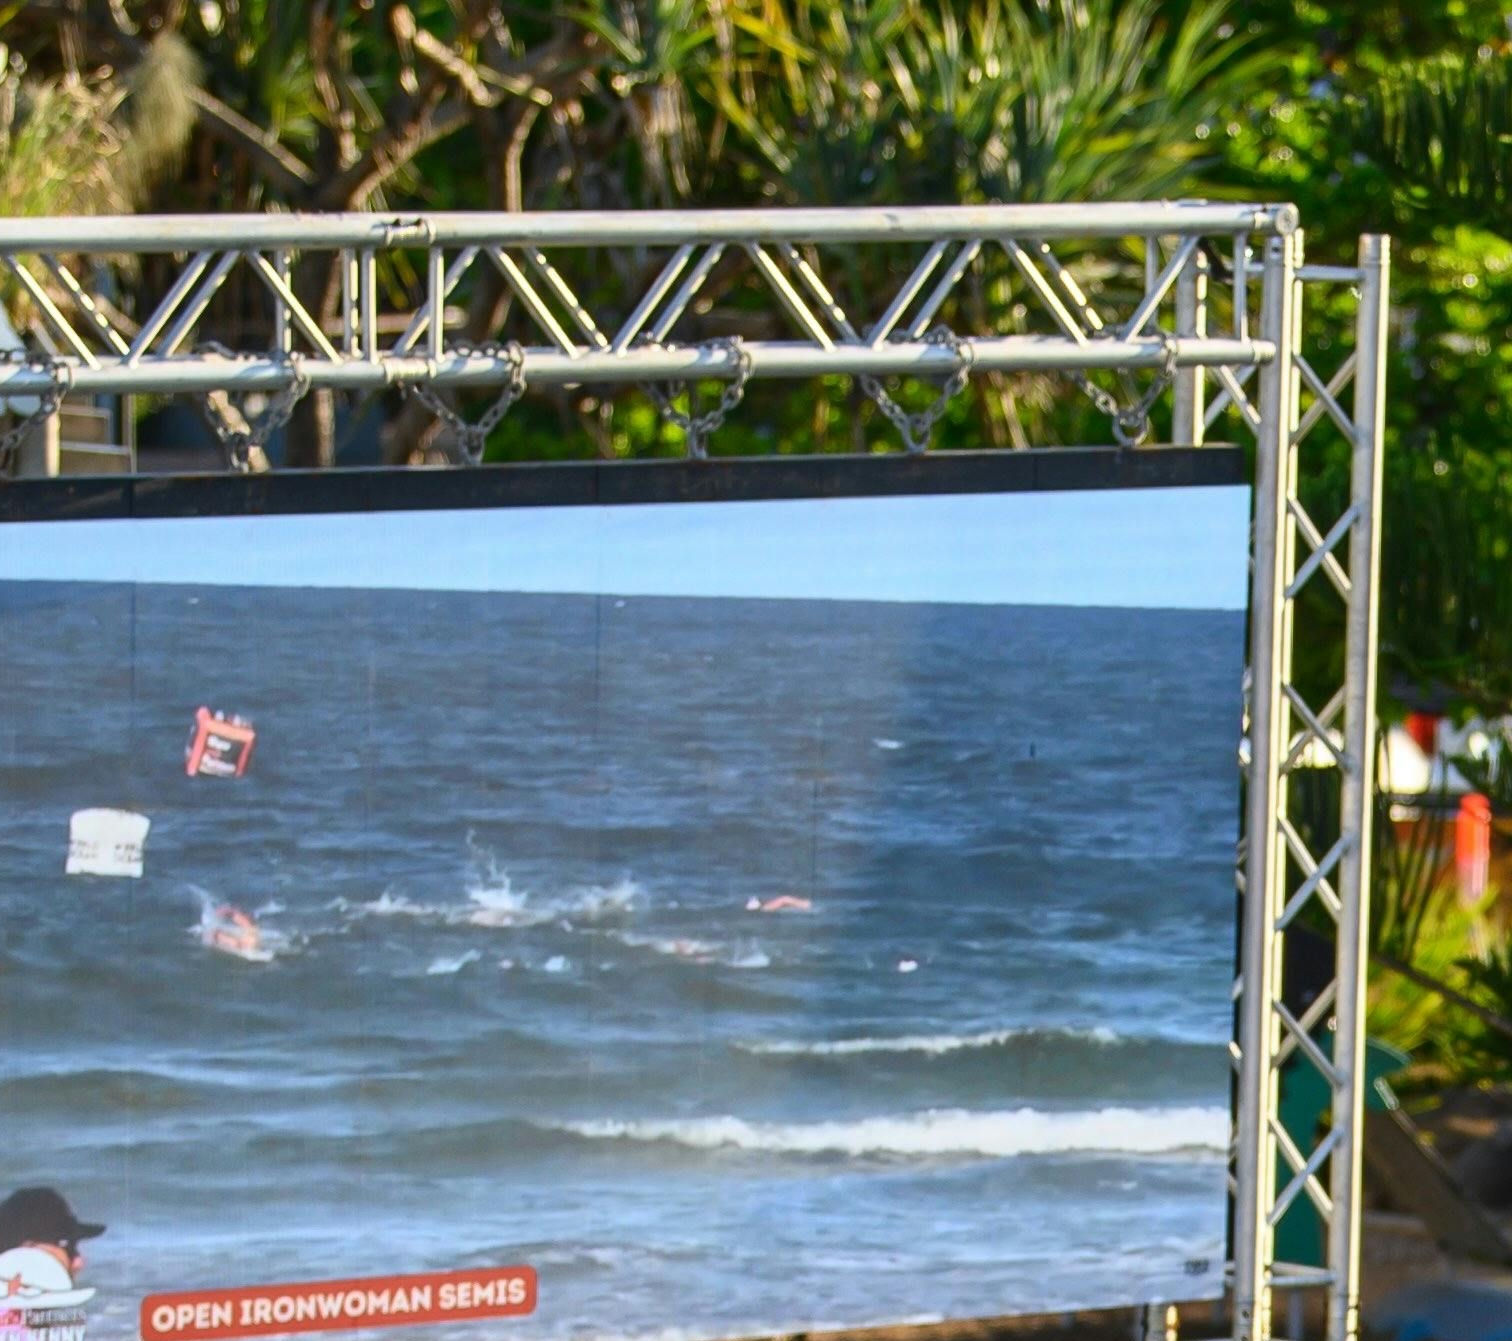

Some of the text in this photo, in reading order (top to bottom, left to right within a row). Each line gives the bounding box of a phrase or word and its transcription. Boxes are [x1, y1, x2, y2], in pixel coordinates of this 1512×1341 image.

[151, 1278, 527, 1332] OPEN IRONWOMAN SEMIS
